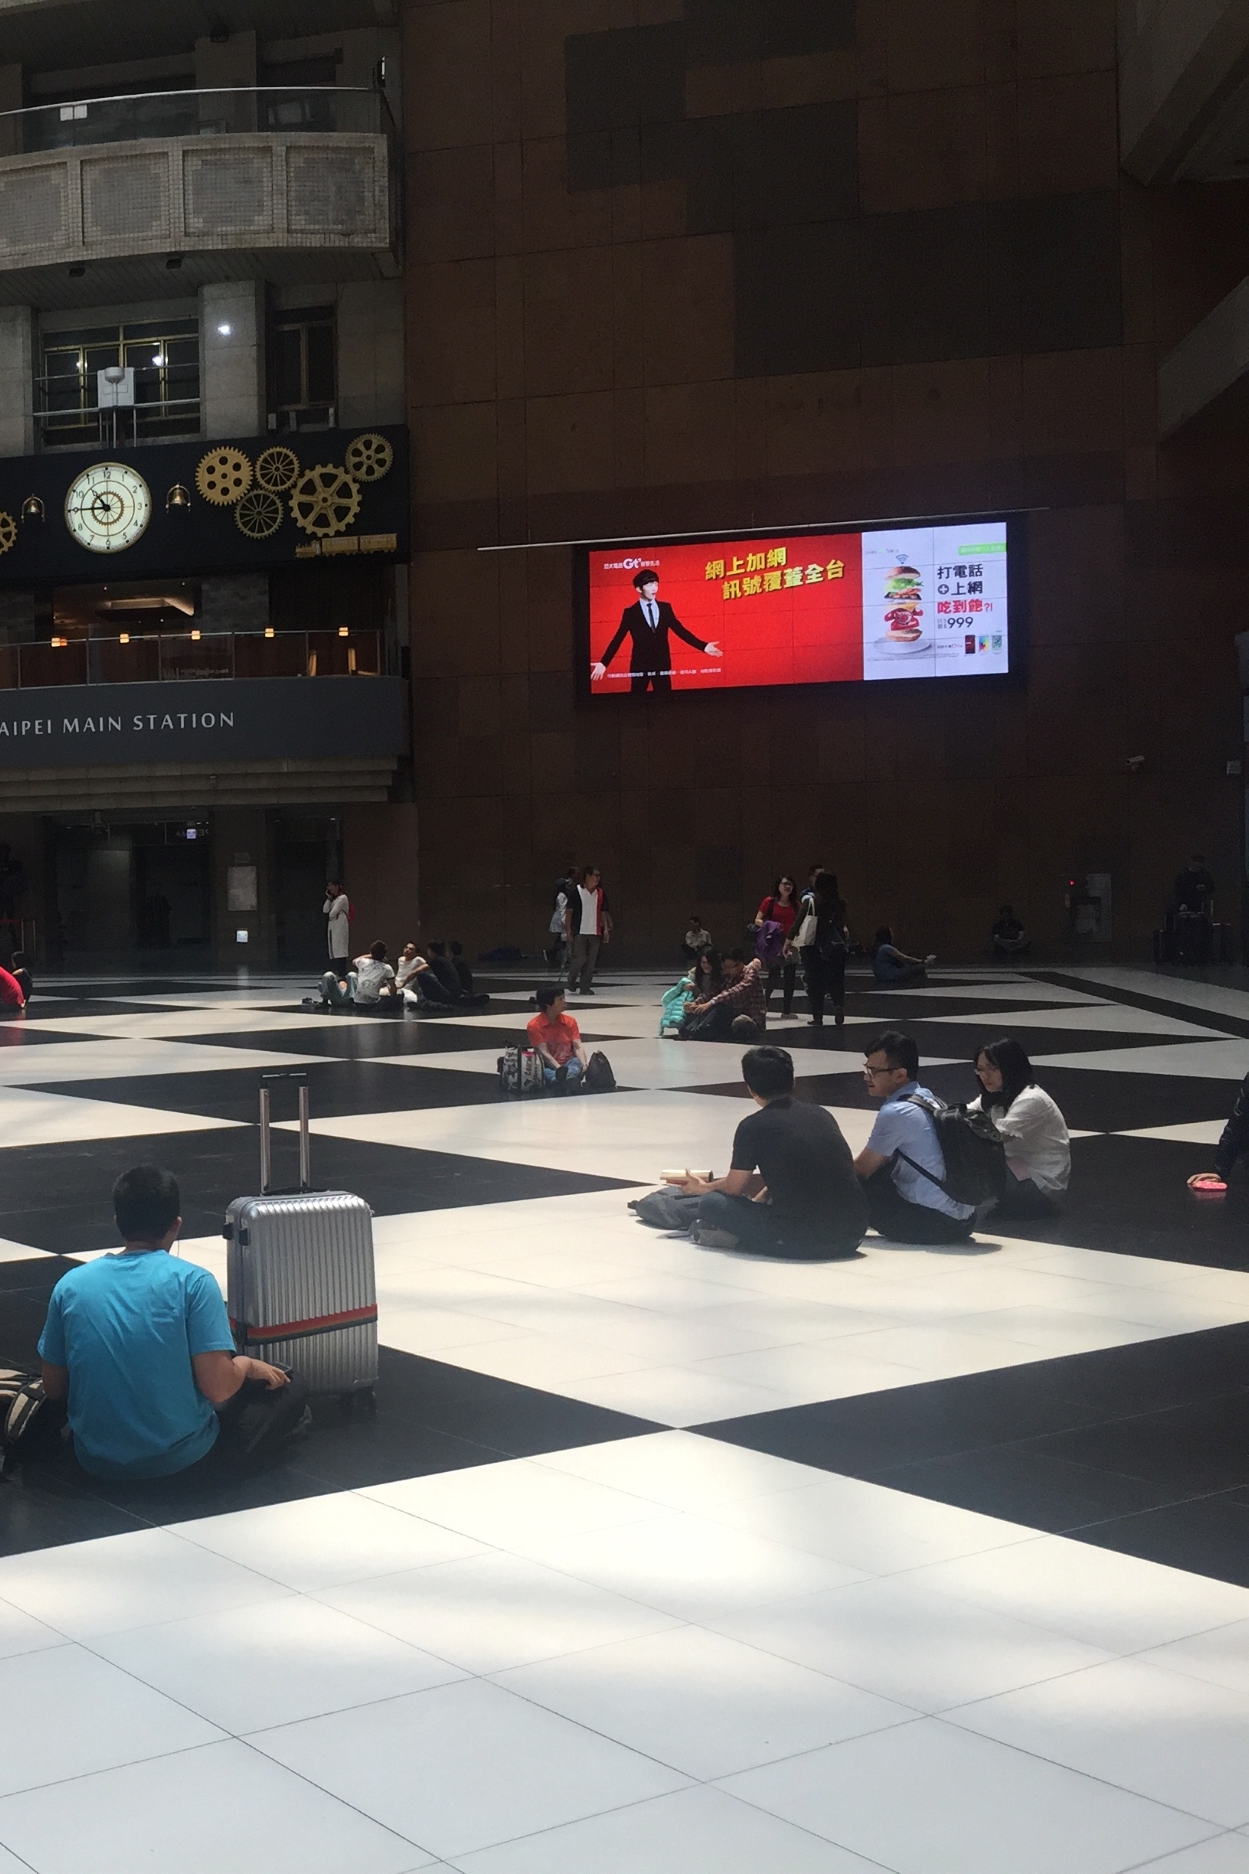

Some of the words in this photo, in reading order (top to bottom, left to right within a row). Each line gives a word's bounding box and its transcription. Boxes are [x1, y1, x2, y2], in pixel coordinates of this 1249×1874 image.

[103, 471, 111, 479] 12
[705, 547, 786, 580] 網上加網
[937, 563, 983, 579] 打電話
[722, 559, 844, 599] 訊號覆蓋全台
[951, 581, 983, 596] 上網
[947, 617, 974, 628] 999
[62, 716, 121, 733] MAIN
[133, 712, 234, 730] STATION
